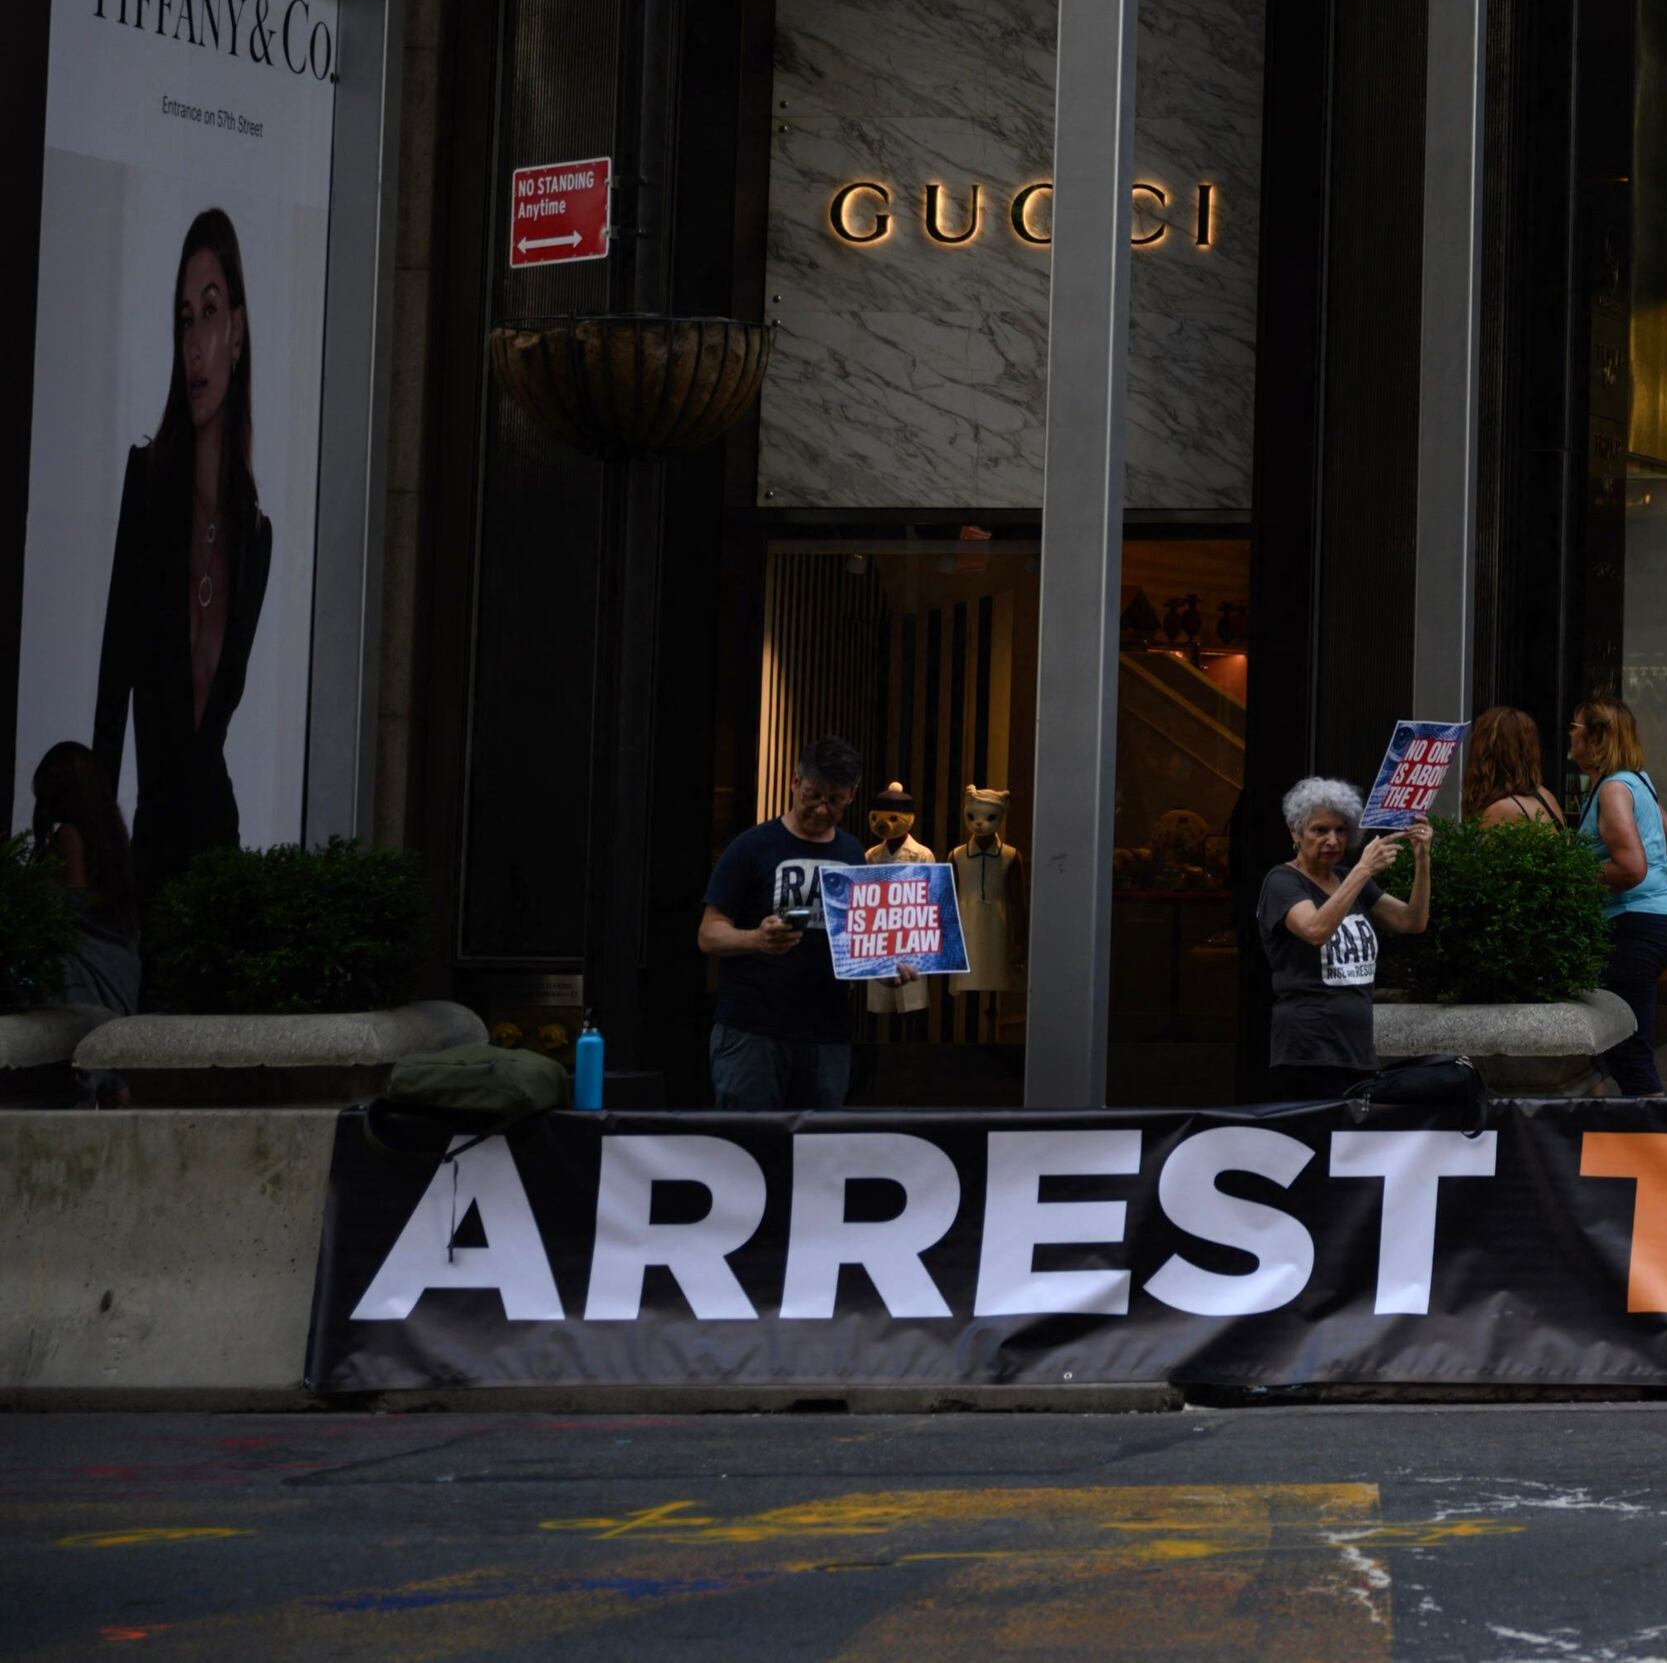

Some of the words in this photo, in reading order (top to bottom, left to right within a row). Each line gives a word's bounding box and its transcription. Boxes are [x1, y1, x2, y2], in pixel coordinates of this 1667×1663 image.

[162, 95, 202, 122] Entrance
[204, 110, 215, 126] on
[217, 110, 236, 131] 57th
[238, 115, 263, 137] Street
[518, 179, 534, 197] NO
[537, 171, 594, 195] STANDING
[518, 199, 566, 221] Anytime
[830, 182, 1213, 245] GUCCI
[1404, 739, 1428, 762] NO
[1426, 741, 1456, 763] ONE
[1390, 762, 1409, 784] IS
[1406, 763, 1450, 787] ABOV
[1384, 786, 1415, 808] THE
[1410, 788, 1439, 810] LA
[781, 866, 821, 907] RA
[852, 883, 880, 908] NO
[888, 882, 927, 905] ONE
[847, 909, 866, 933] IS
[872, 905, 939, 932] ABOVE
[852, 932, 888, 957] THE
[895, 929, 941, 953] LAW
[1326, 921, 1375, 965] RAR
[350, 1125, 1497, 1322] ARREST
